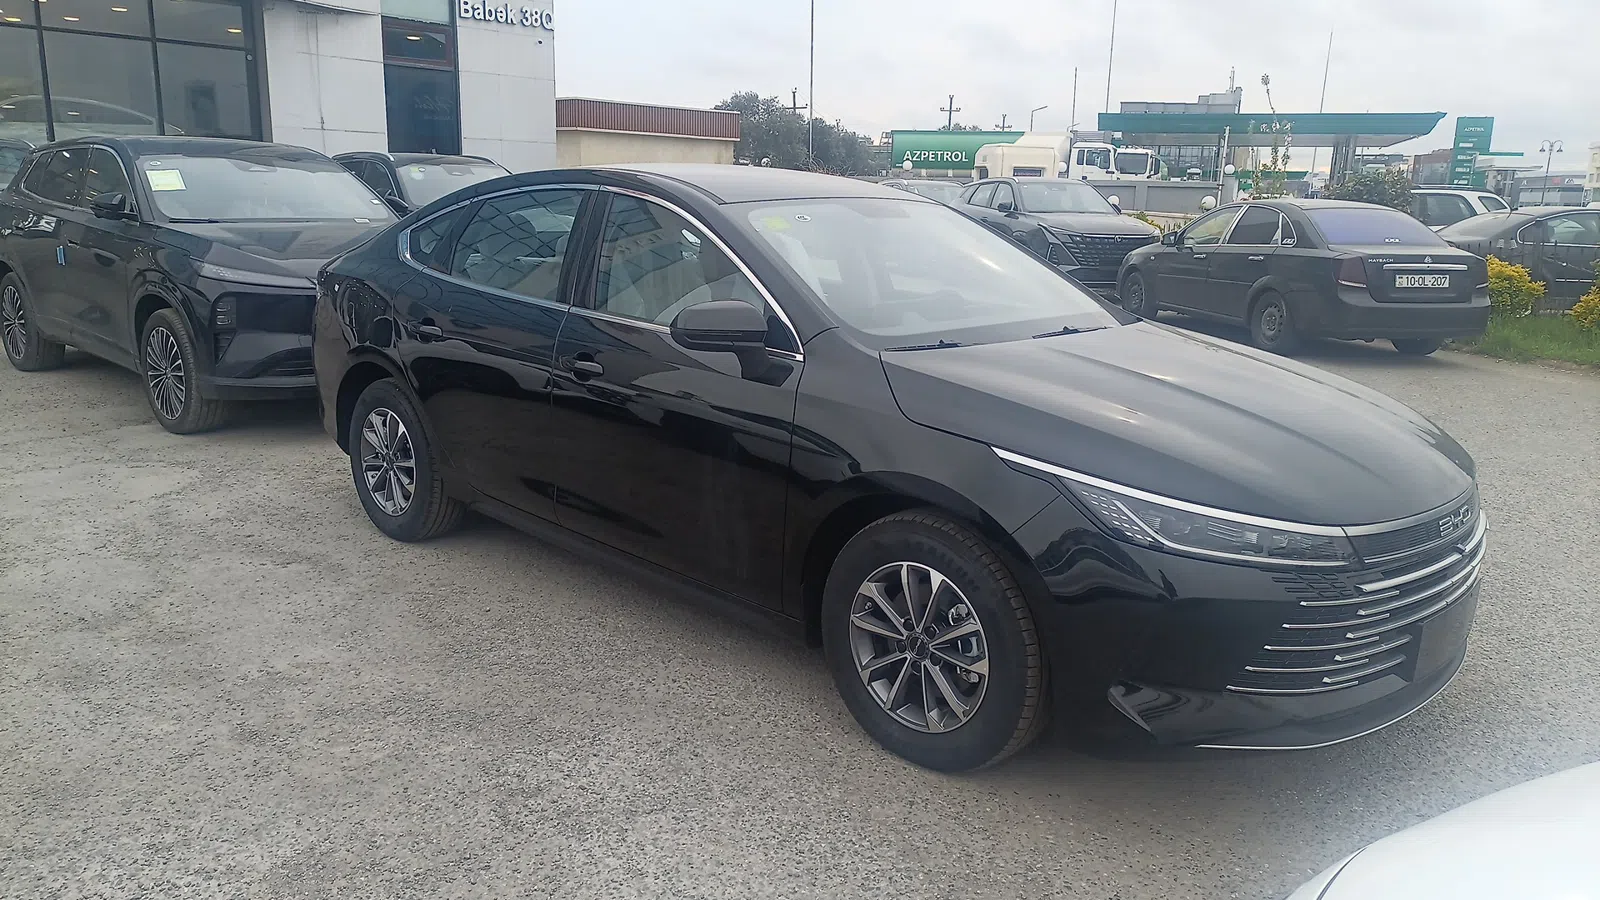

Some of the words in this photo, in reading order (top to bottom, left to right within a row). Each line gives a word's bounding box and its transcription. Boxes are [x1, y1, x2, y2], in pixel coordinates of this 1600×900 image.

[459, 0, 517, 25] Babək
[520, 6, 555, 31] 38Q
[903, 150, 969, 162] AZPETROL
